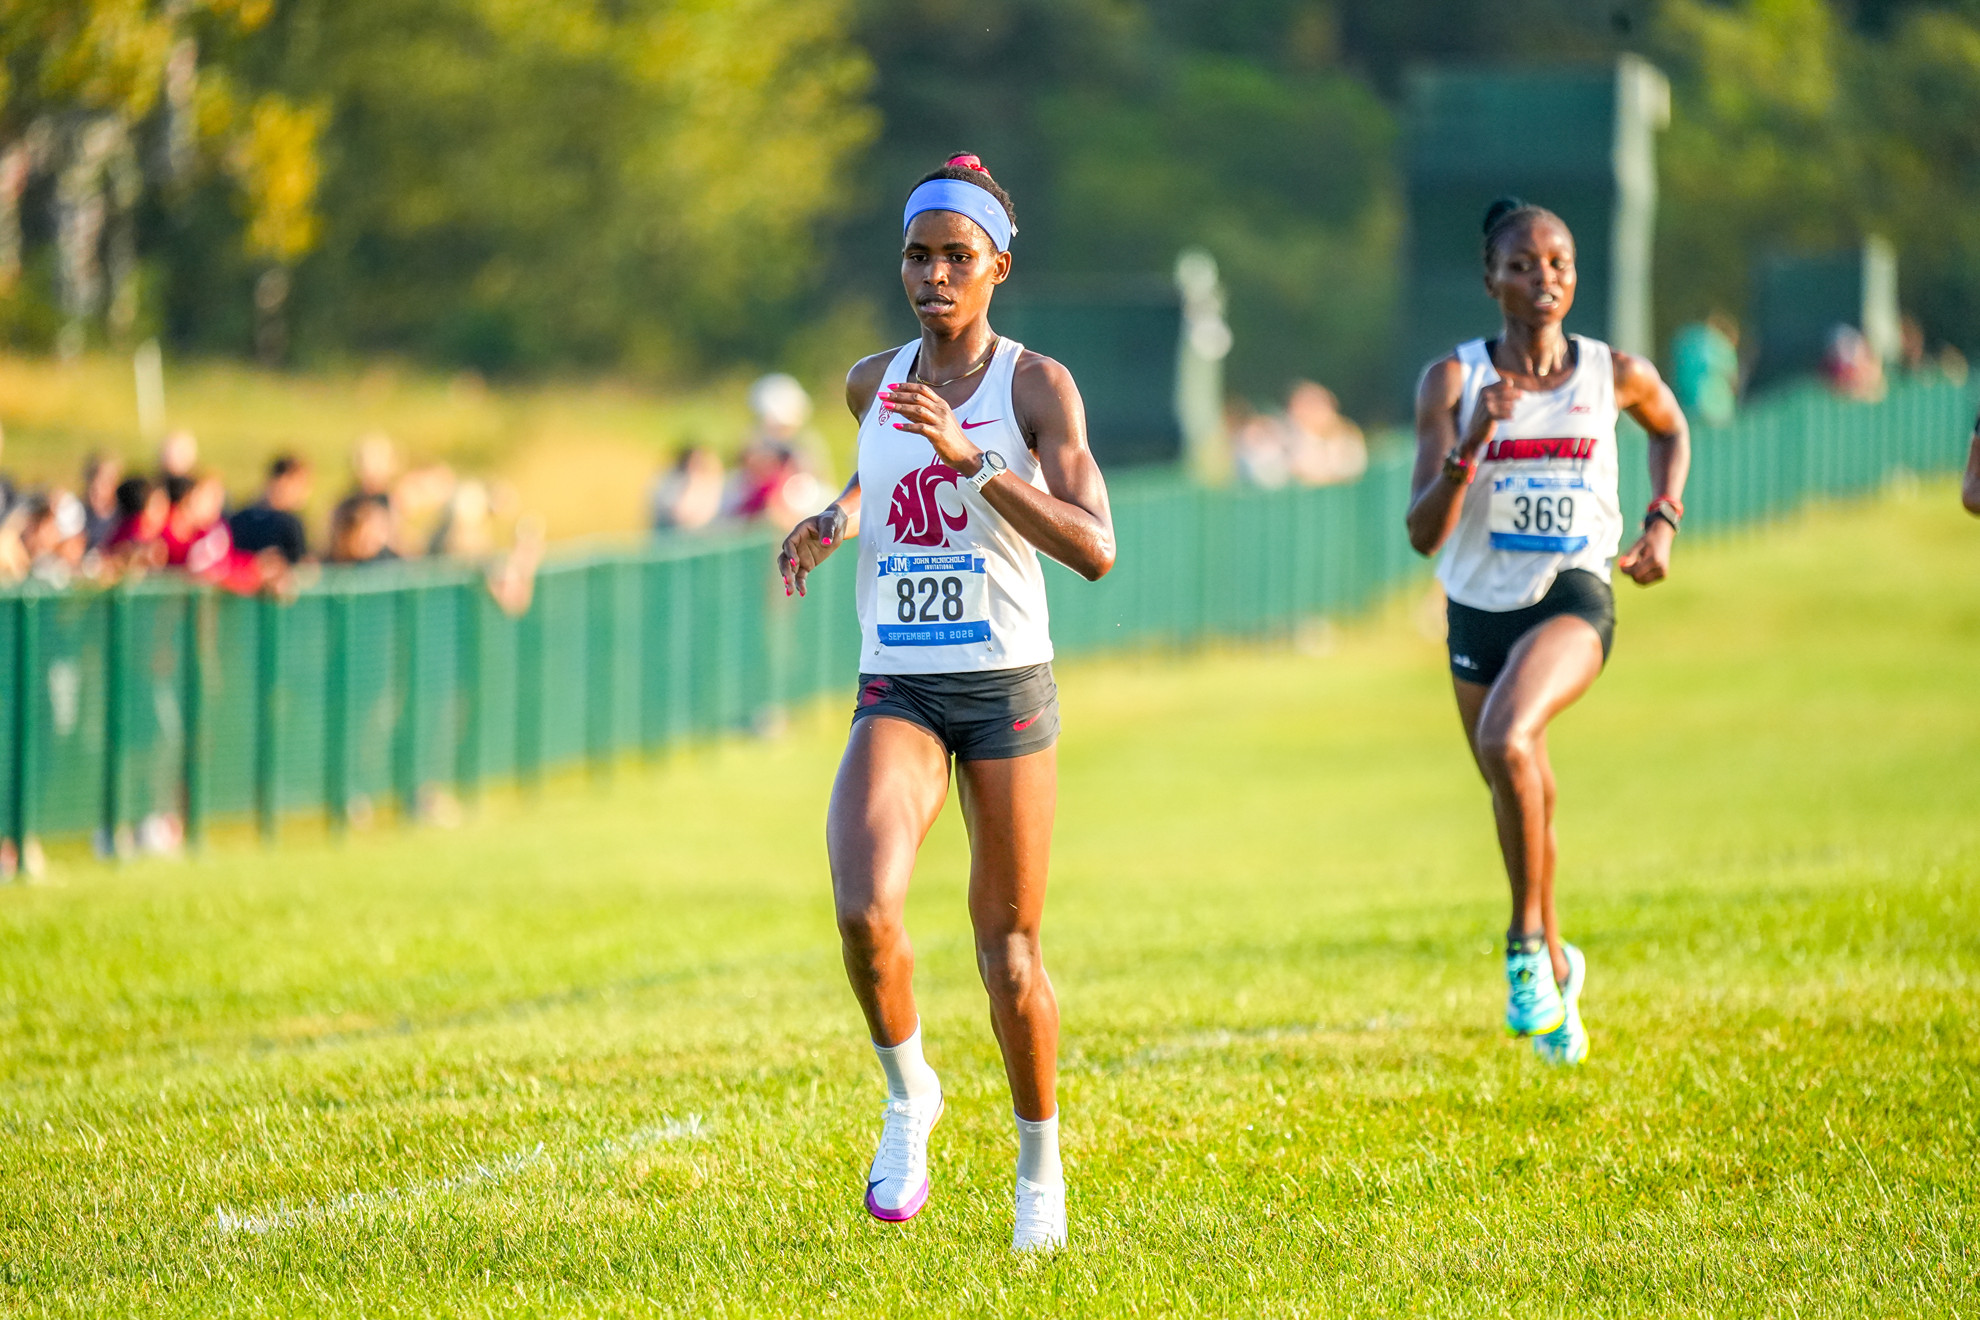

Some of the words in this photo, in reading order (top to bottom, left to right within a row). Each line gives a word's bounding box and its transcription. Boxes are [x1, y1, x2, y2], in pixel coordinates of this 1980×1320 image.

[1513, 496, 1574, 533] 369
[890, 557, 909, 572] JM
[912, 557, 930, 565] JOHN
[924, 563, 955, 571] INVITATIONAL
[896, 576, 964, 623] 828
[888, 631, 932, 641] SEPTEMBER
[949, 629, 974, 639] 2026
